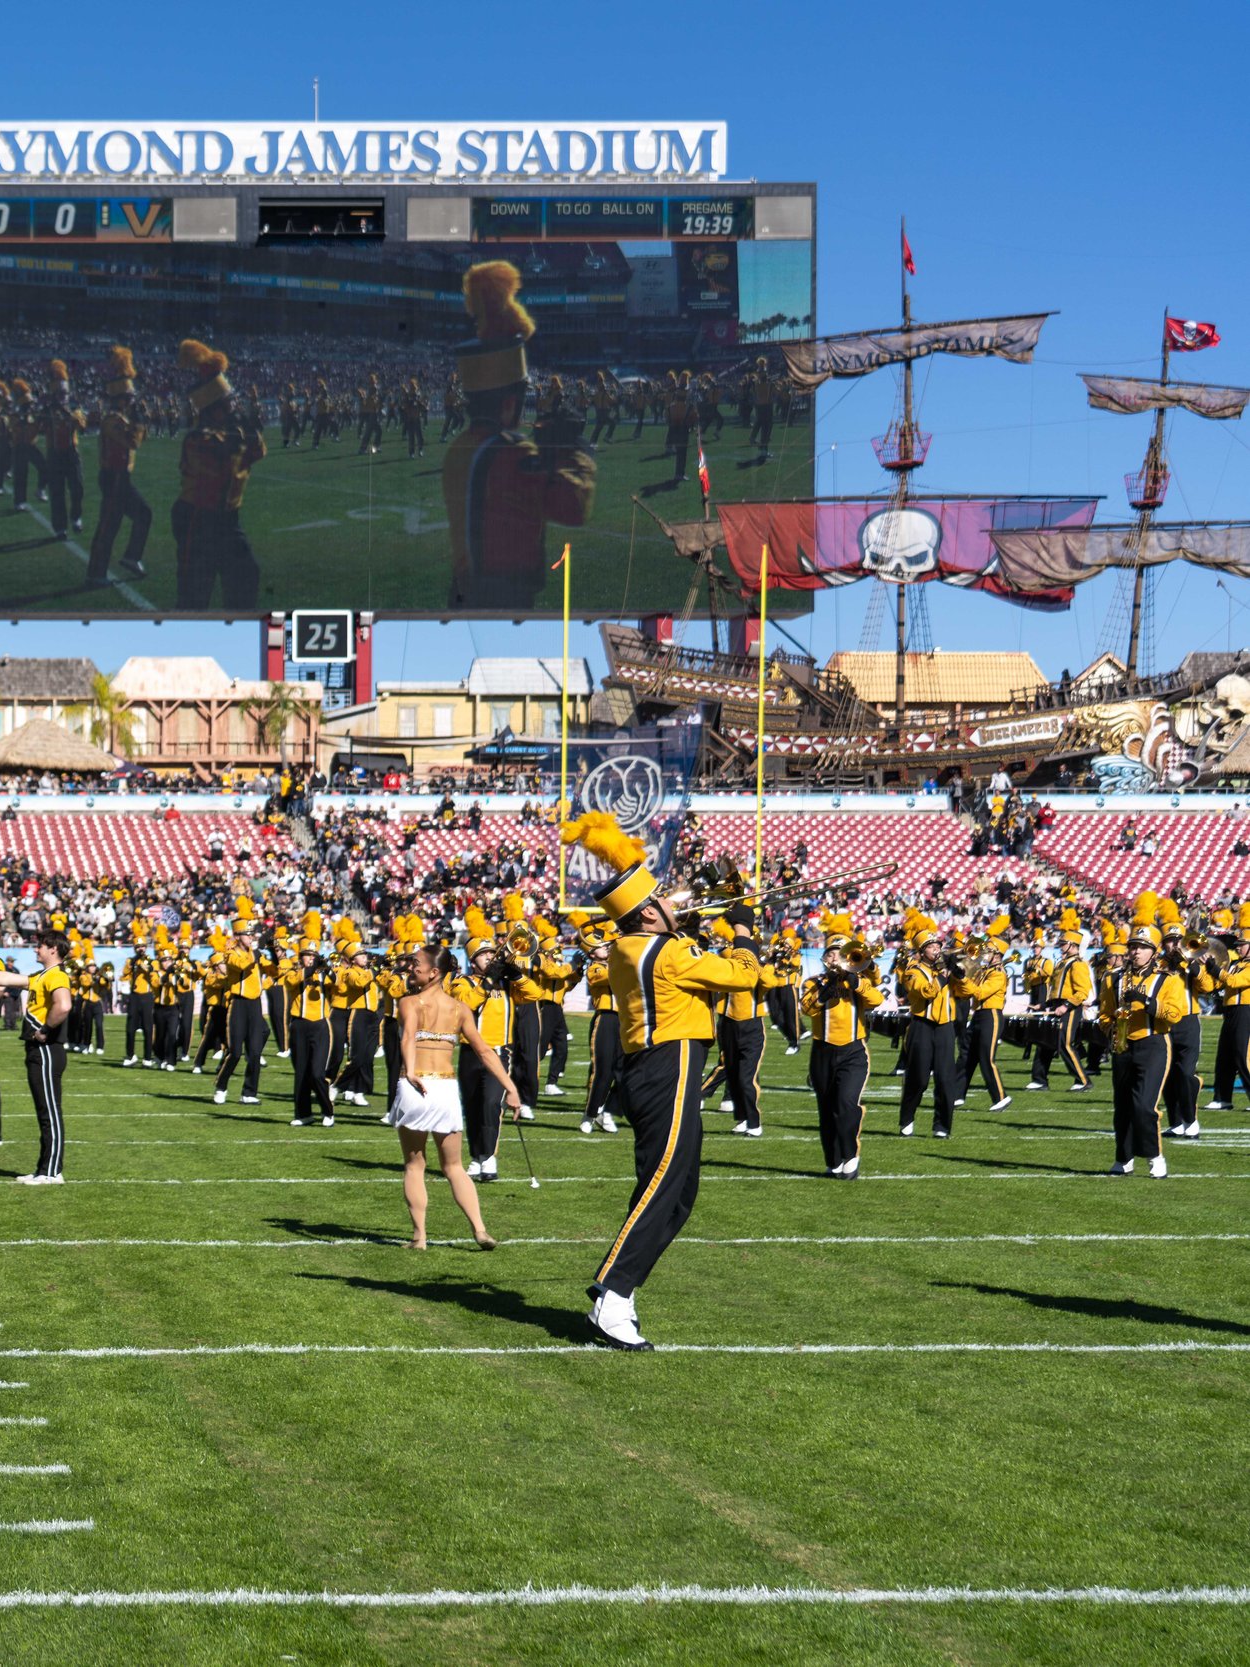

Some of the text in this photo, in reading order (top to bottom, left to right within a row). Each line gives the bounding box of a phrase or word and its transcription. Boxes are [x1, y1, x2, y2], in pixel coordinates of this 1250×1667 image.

[244, 129, 442, 177] JAMES
[454, 129, 719, 177] STADIUM
[490, 203, 530, 216] DOWN
[556, 203, 592, 216] TO GO
[602, 203, 654, 216] BALL ON
[682, 202, 734, 215] PREGAME
[53, 203, 77, 236] 0
[682, 215, 734, 236] 19:39
[304, 622, 339, 651] 25
